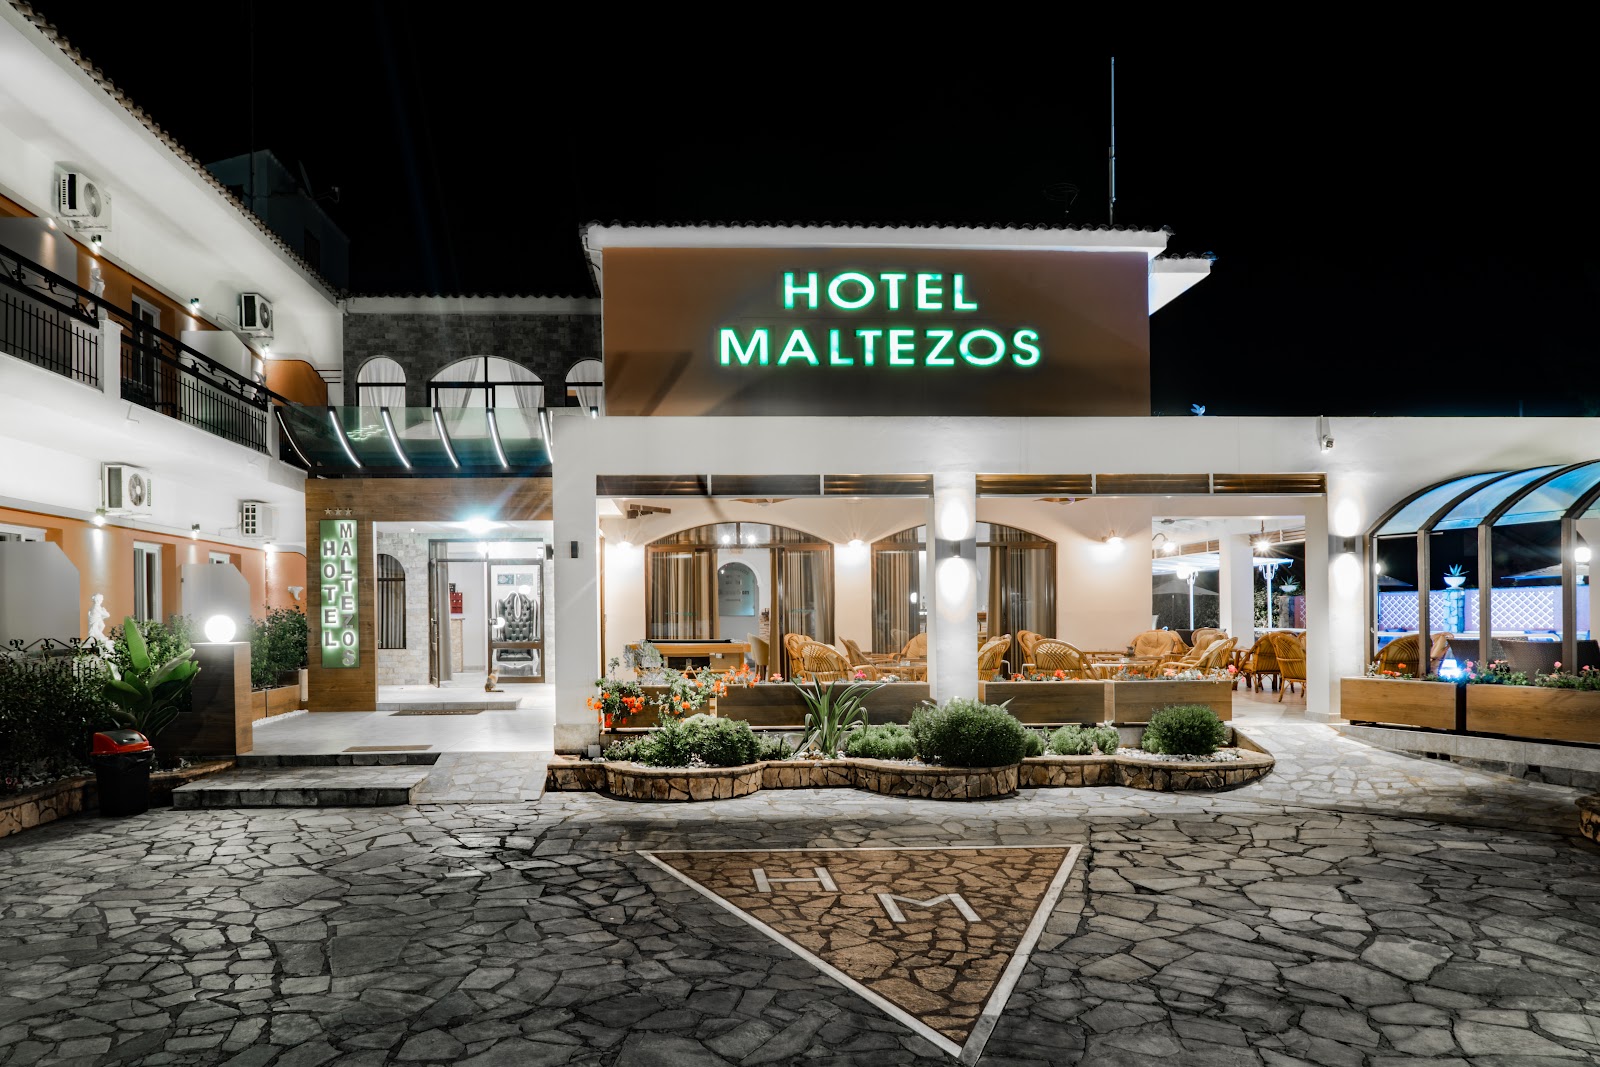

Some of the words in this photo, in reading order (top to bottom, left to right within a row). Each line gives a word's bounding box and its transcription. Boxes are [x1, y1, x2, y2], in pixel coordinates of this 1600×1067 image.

[783, 271, 979, 312] HOTEL
[718, 328, 1042, 368] MALTEZOS
[323, 540, 338, 648] HOTEL
[339, 522, 356, 667] MALTEZOS
